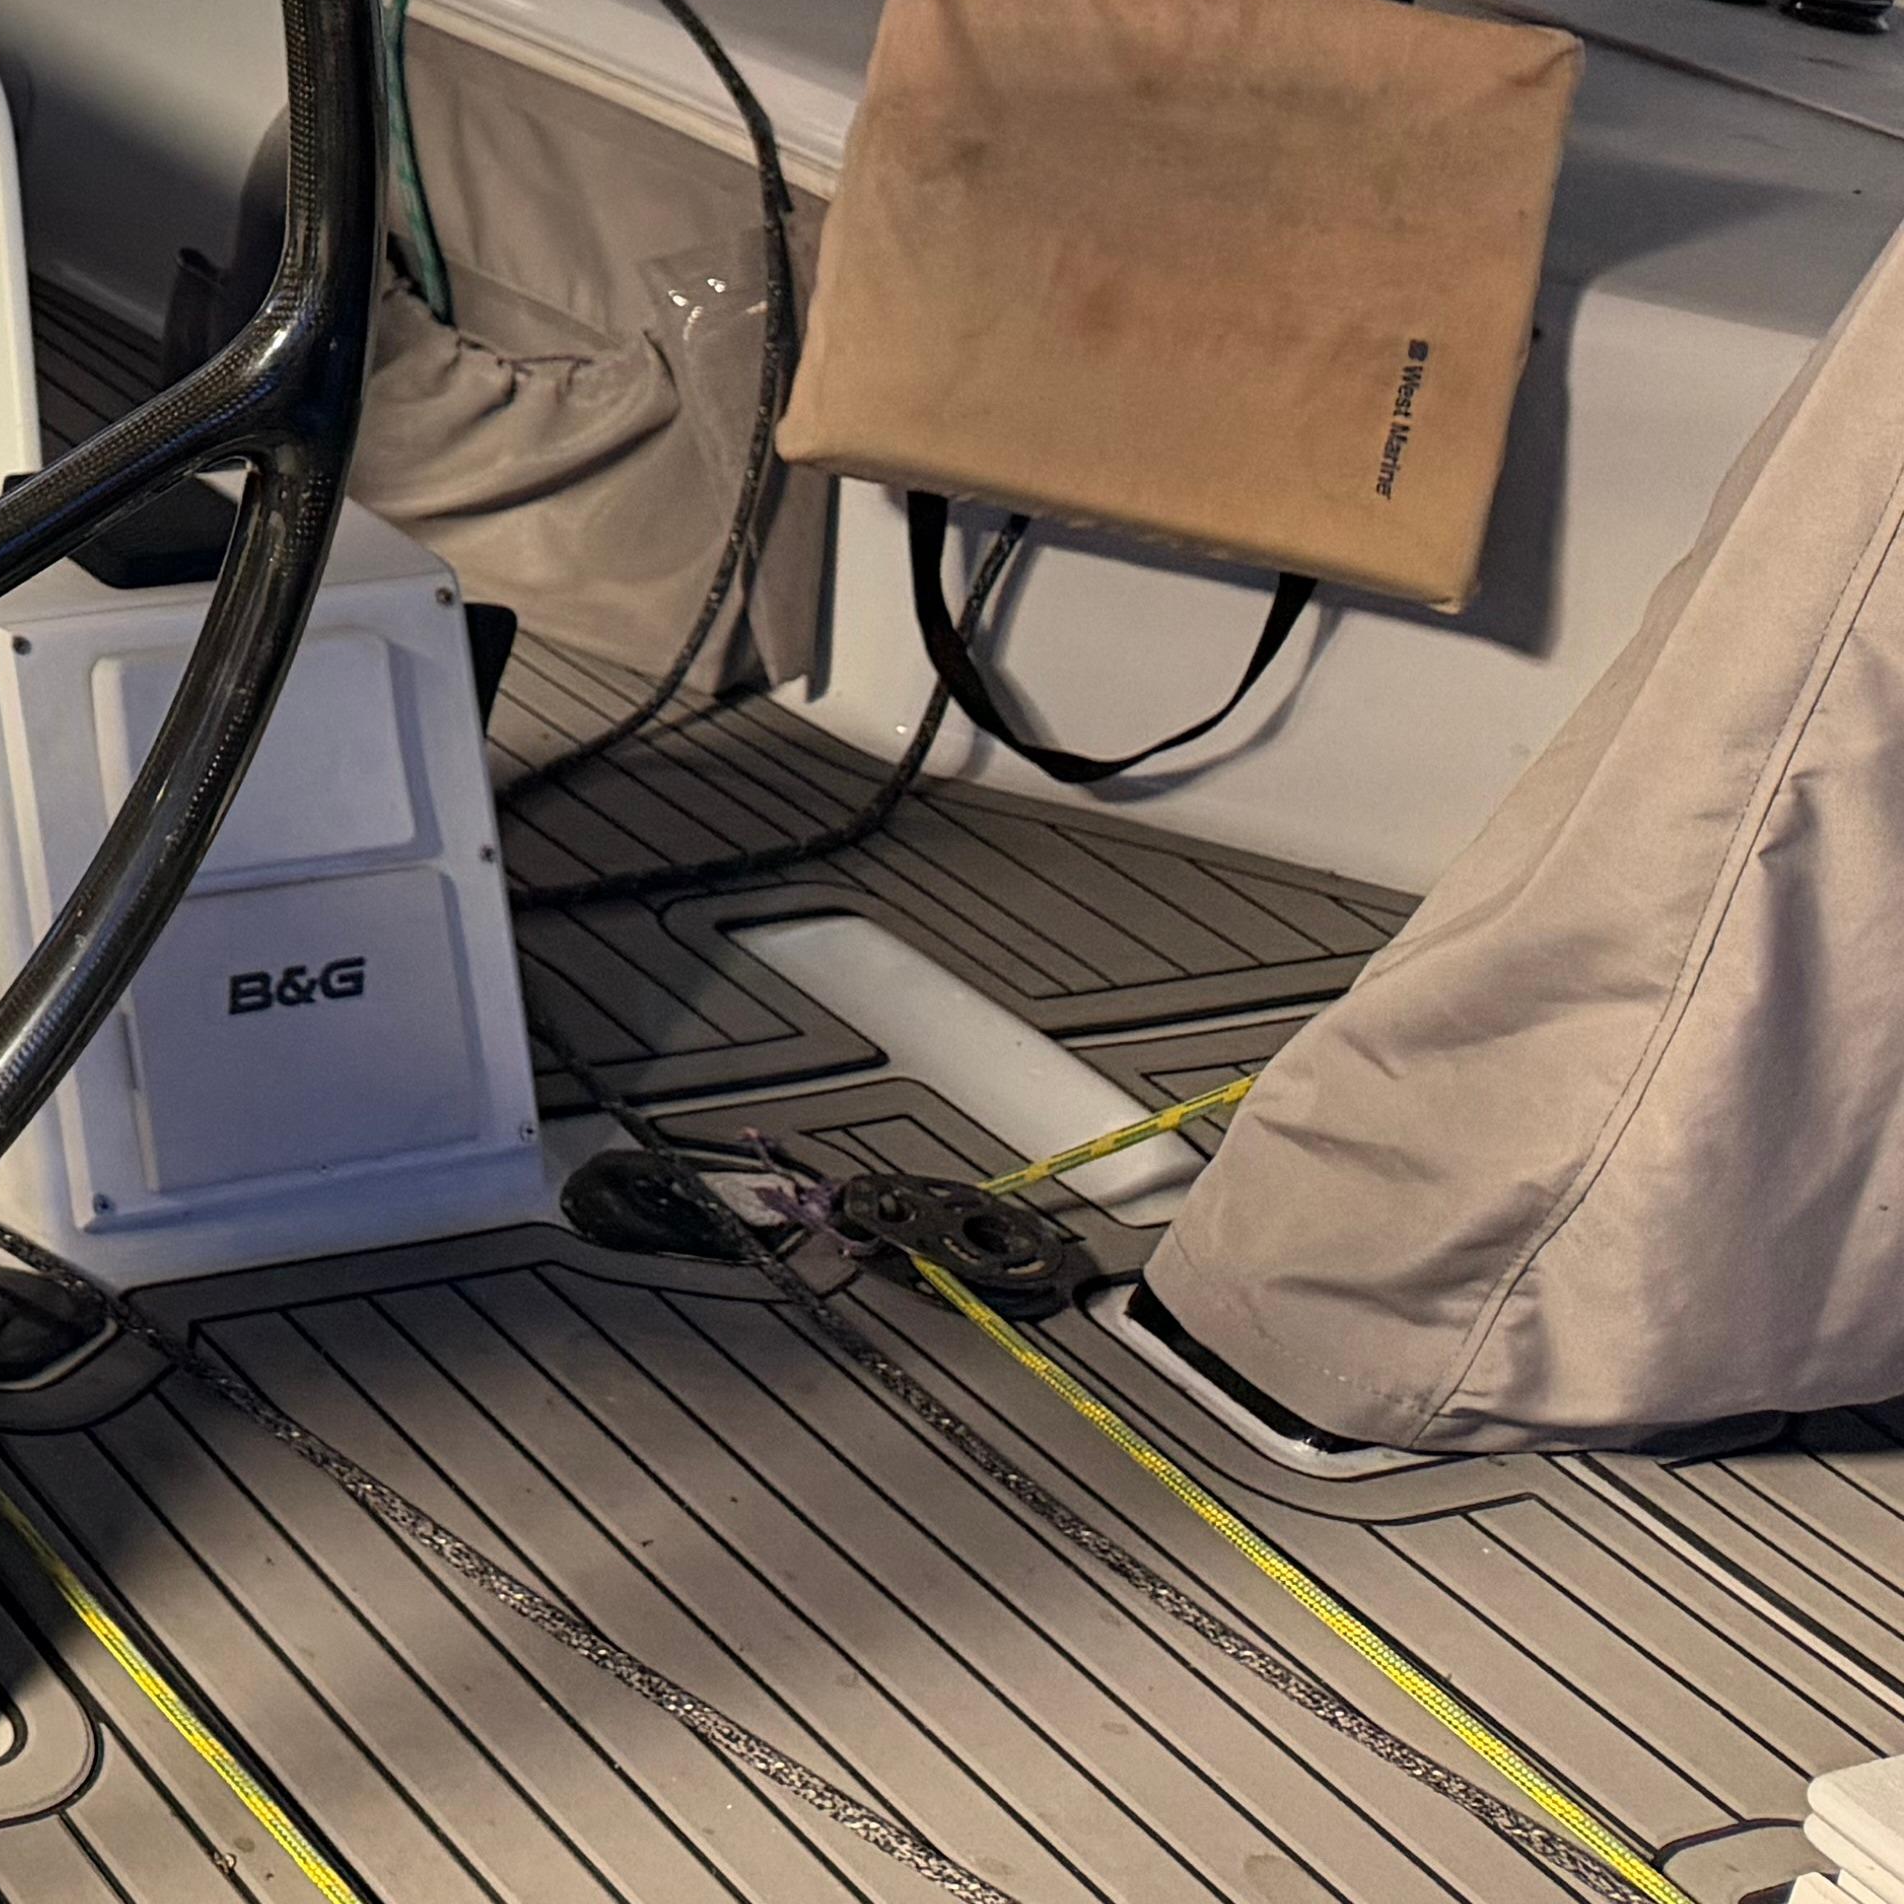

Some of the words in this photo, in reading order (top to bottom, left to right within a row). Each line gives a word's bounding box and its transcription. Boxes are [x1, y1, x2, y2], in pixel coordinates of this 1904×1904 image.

[1392, 365, 1423, 418] West
[1376, 422, 1411, 499] Marine
[228, 955, 366, 1015] B&G
